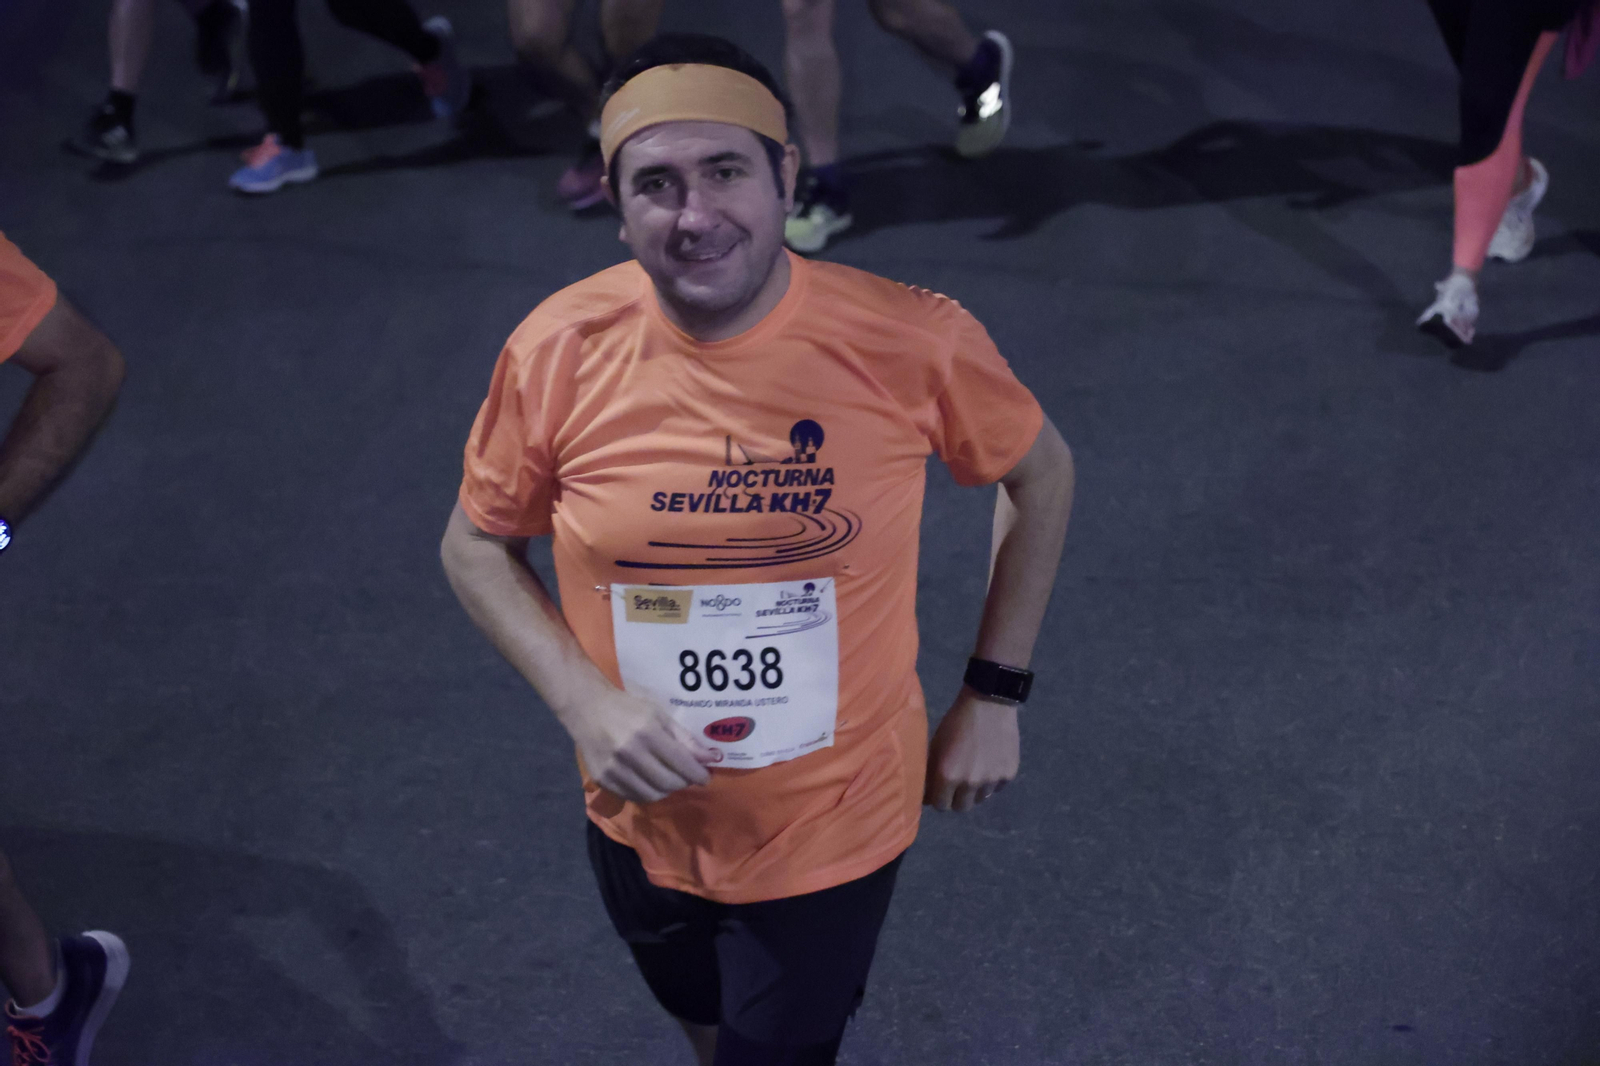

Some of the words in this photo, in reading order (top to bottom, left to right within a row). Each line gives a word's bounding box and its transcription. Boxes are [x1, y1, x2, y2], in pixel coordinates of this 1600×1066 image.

[708, 468, 835, 487] NOCTURNA
[651, 492, 763, 513] SEVILLA
[756, 606, 794, 617] SEVILLA
[679, 647, 783, 692] 8638
